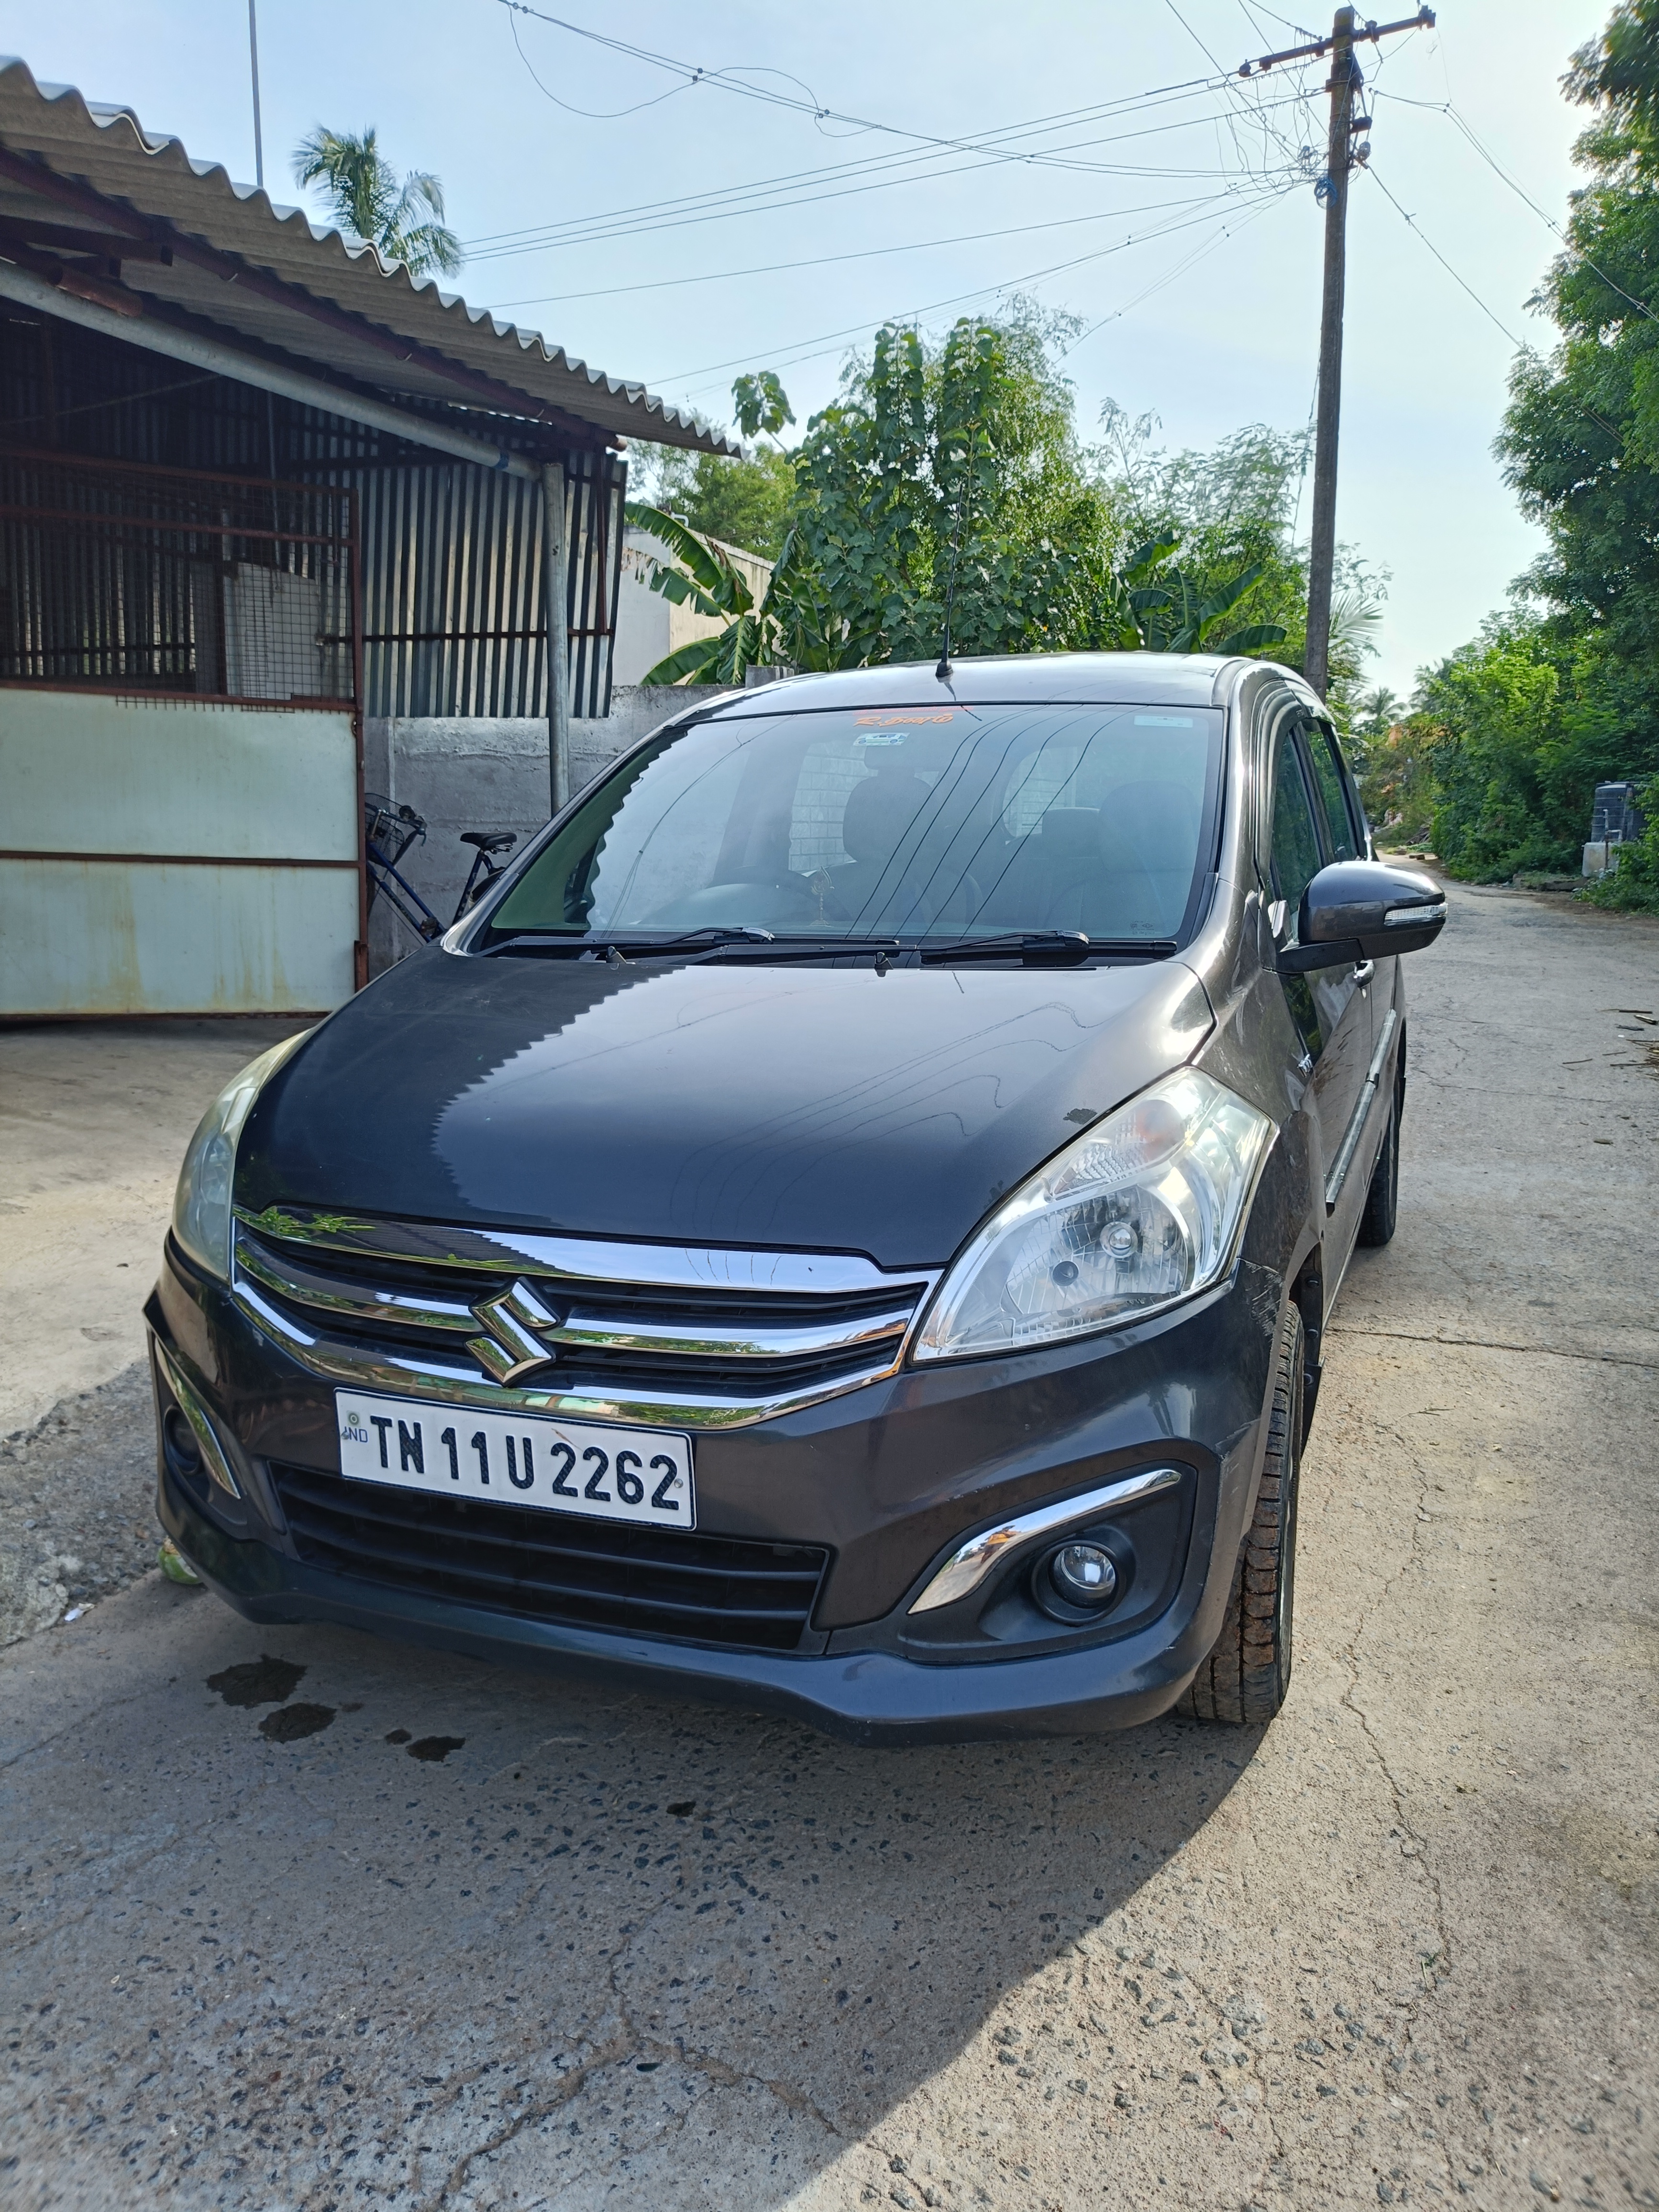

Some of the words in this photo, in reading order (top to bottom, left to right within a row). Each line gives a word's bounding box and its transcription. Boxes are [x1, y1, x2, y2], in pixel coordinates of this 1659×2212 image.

[370, 1415, 425, 1474] TN
[441, 1427, 490, 1484] 11
[506, 1435, 534, 1489] U
[550, 1442, 679, 1511] 2262
